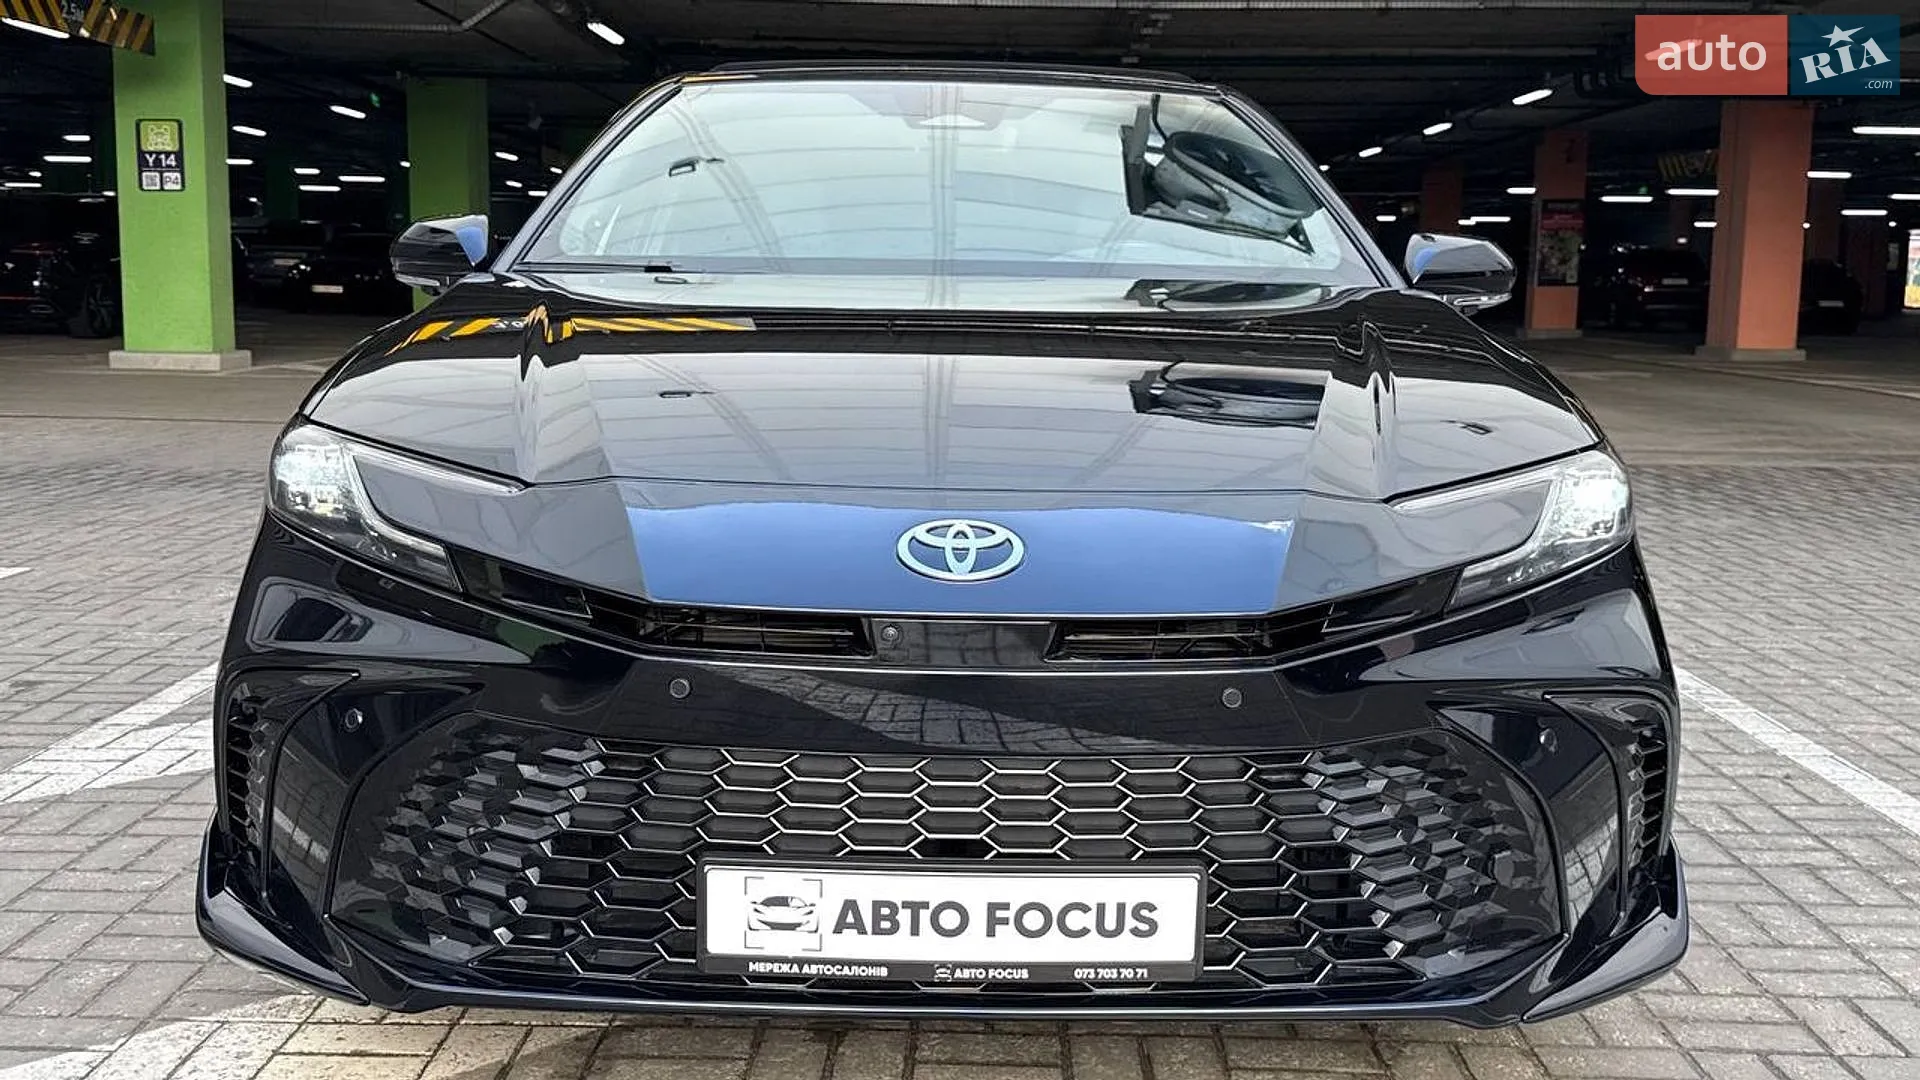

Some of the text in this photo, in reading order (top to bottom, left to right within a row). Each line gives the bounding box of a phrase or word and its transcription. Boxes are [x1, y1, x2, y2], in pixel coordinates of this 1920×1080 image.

[144, 153, 177, 167] Y 14
[832, 898, 1160, 939] АВТО FOCUS
[748, 961, 889, 977] МЕРЕЖА АВТОСАЛОНІВ
[988, 968, 1029, 980] FOCUS
[1073, 968, 1149, 980] 073 703 70 71
